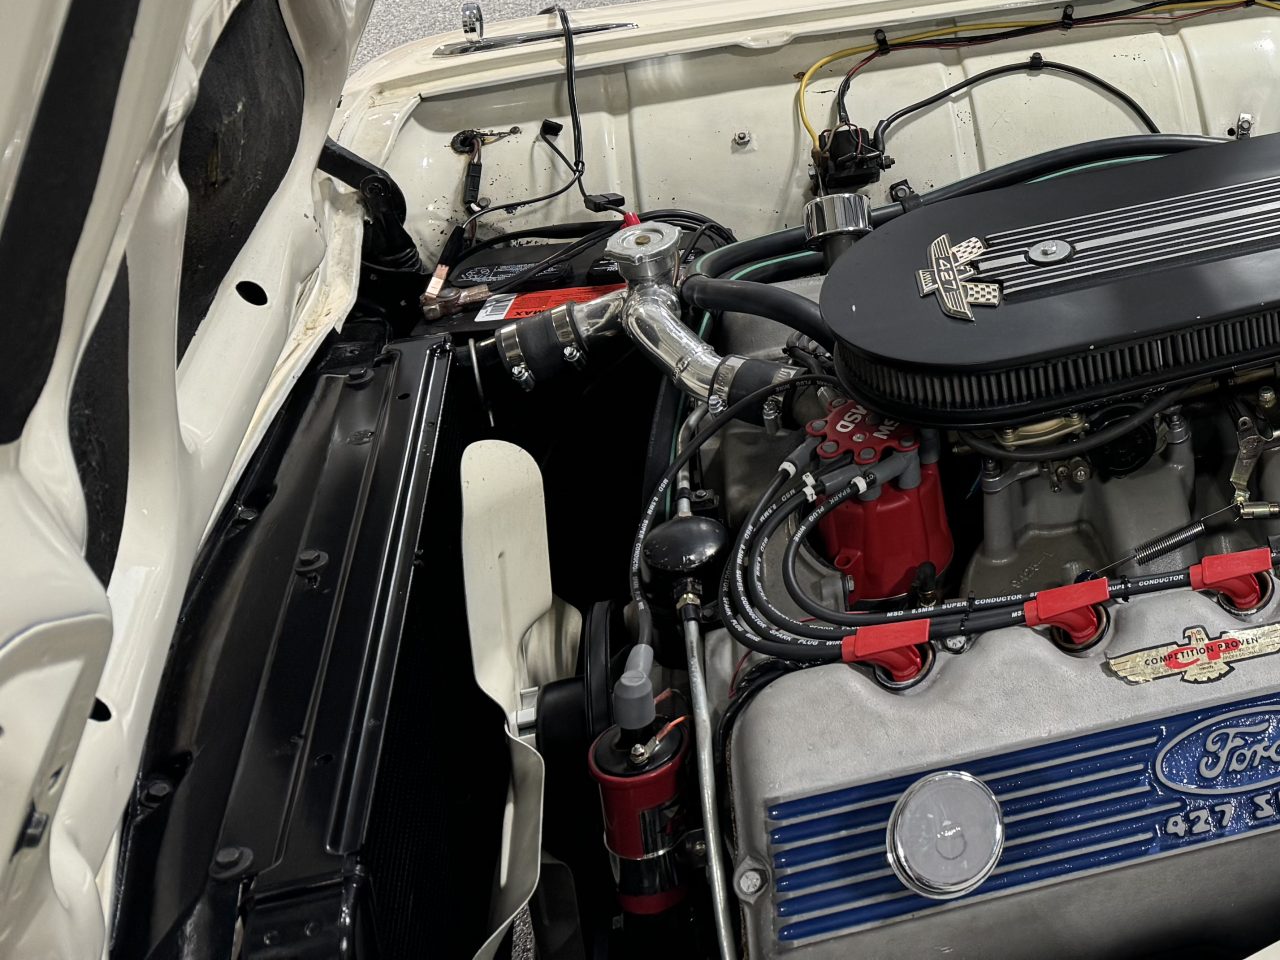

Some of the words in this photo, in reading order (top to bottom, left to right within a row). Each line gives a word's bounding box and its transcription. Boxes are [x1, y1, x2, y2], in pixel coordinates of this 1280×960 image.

[939, 259, 957, 289] 427
[658, 478, 669, 492] MSD
[808, 505, 825, 522] PLUG
[638, 519, 649, 539] SUPER
[793, 525, 806, 542] WIRE
[1138, 574, 1184, 587] CONDUCTOR
[736, 570, 744, 591] SUPER
[740, 596, 767, 629] CONDUCTOR
[770, 629, 793, 642] SPARK
[941, 601, 967, 609] SUPER
[974, 594, 1022, 605] CONDUCTOR
[730, 619, 744, 632] PLUG
[1144, 645, 1214, 667] COMPETITION
[1217, 636, 1259, 651] PROVEN
[1166, 803, 1236, 837] 427
